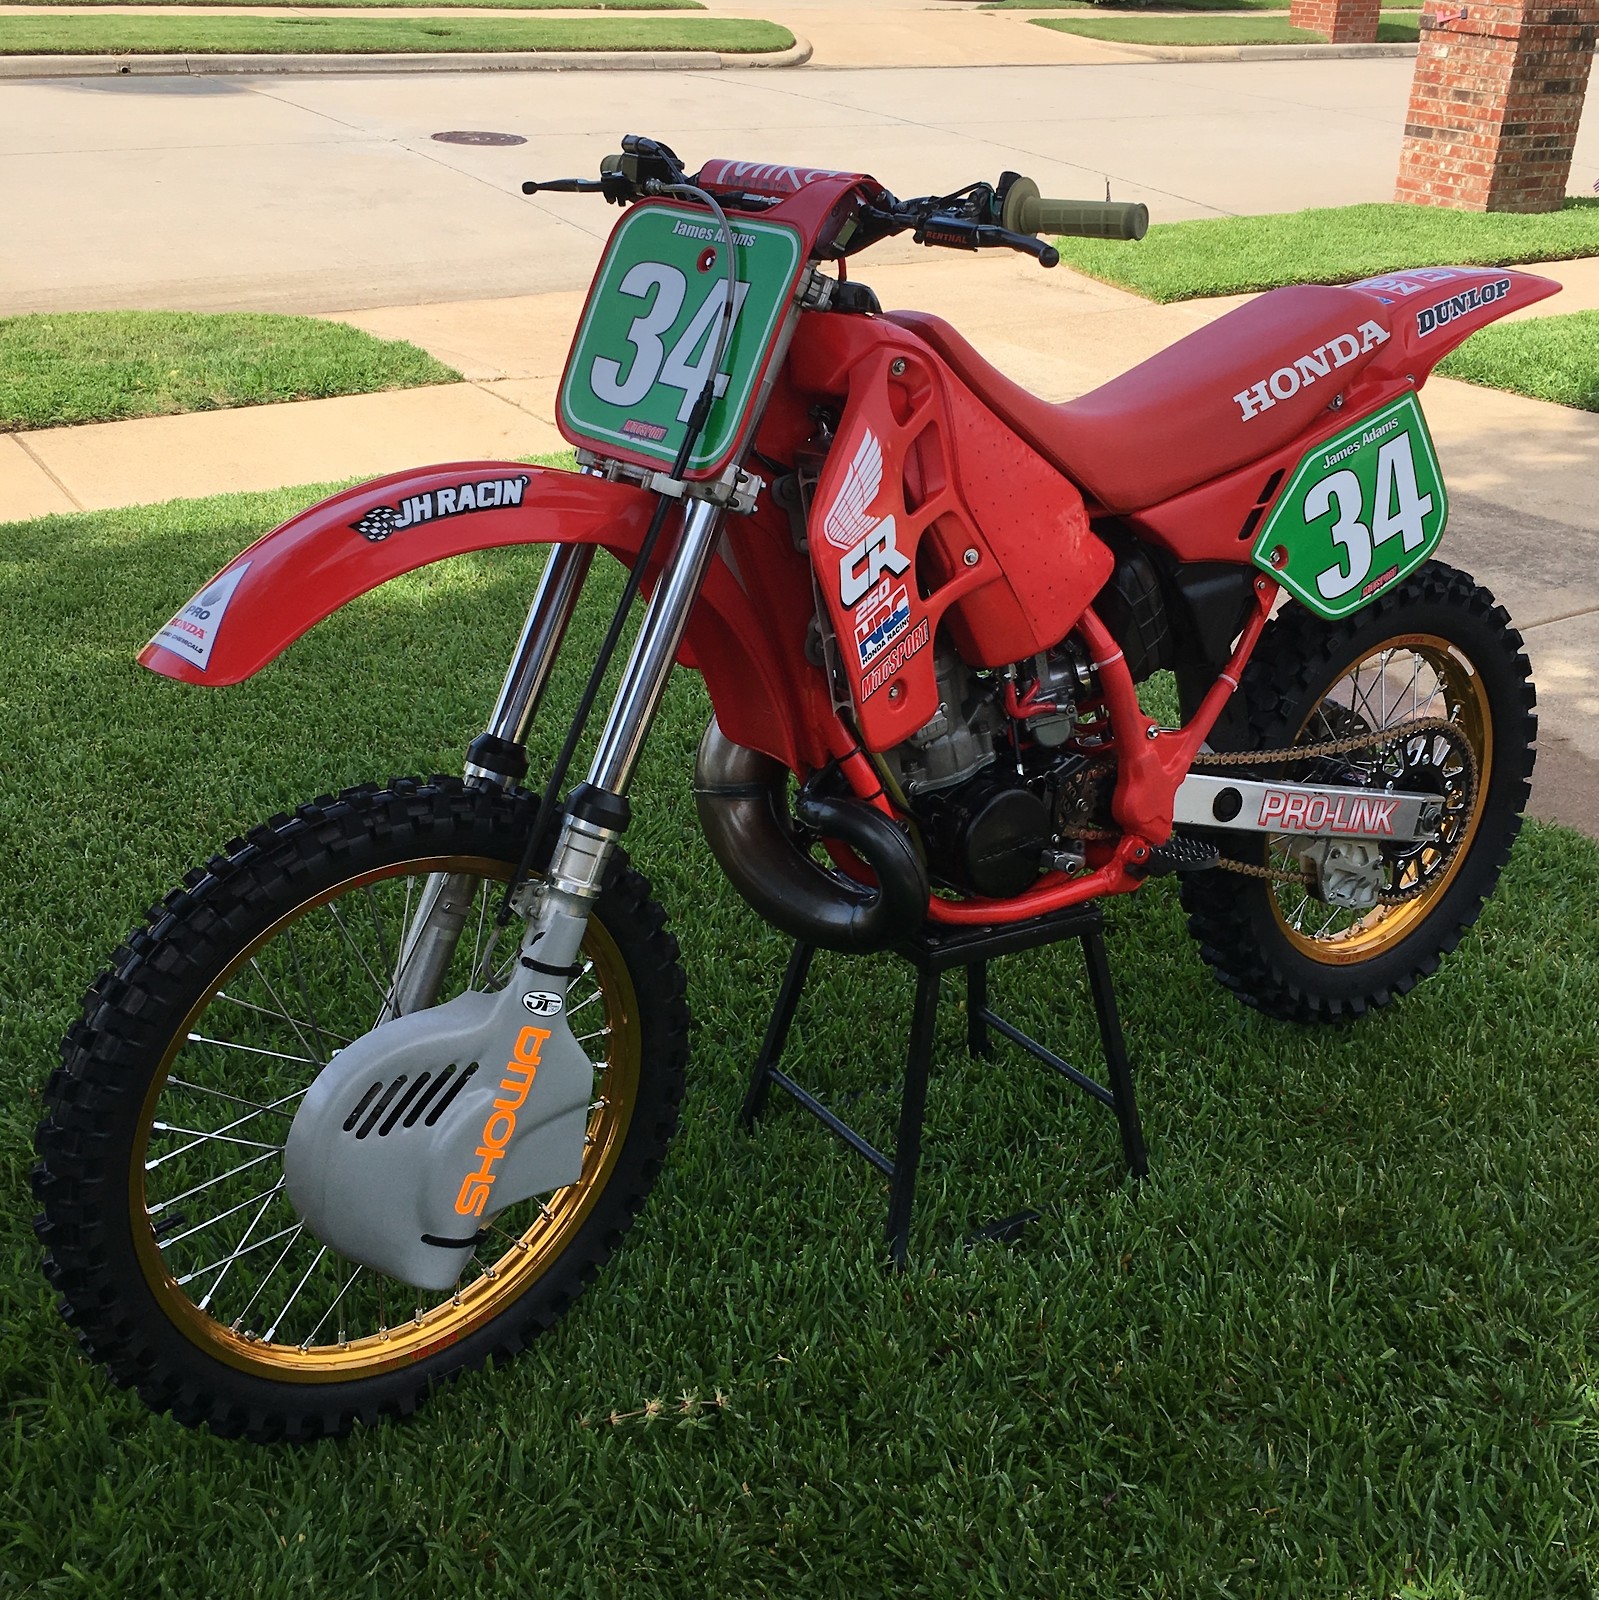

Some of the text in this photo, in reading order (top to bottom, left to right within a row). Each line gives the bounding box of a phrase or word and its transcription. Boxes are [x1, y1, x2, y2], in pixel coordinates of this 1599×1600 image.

[672, 220, 714, 241] James
[926, 230, 967, 244] RENTHAL
[1417, 279, 1511, 337] DUNLOP
[590, 261, 751, 423] 34
[1233, 320, 1391, 422] HONDA
[1323, 418, 1399, 470] James Adams
[394, 494, 433, 527] JH
[1304, 431, 1433, 600] 34
[840, 514, 912, 608] CR
[185, 605, 211, 620] PRO
[856, 577, 890, 625] 250
[172, 634, 205, 653] CHEMICALS
[862, 641, 887, 666] HONDA
[1258, 790, 1401, 835] PRO-LINK
[454, 1025, 552, 1217] SHOWA
